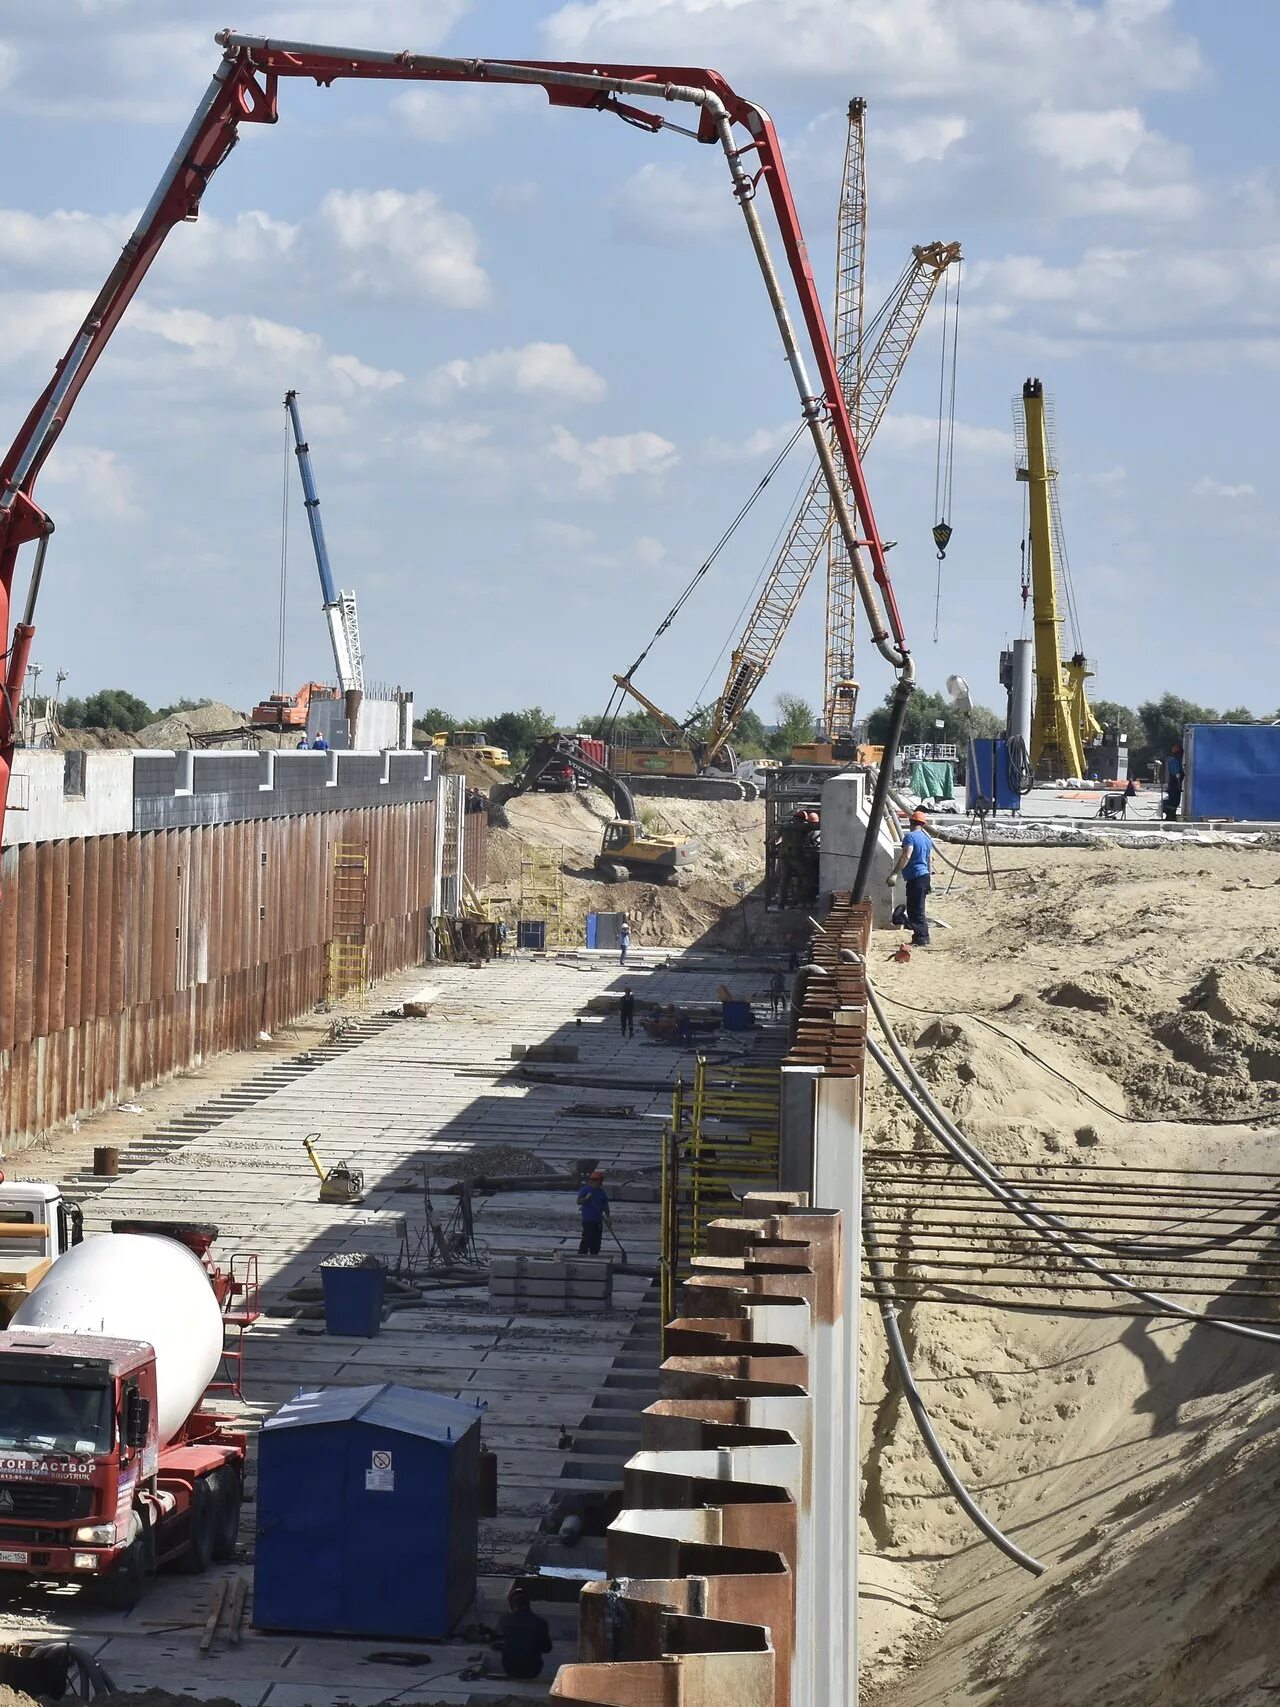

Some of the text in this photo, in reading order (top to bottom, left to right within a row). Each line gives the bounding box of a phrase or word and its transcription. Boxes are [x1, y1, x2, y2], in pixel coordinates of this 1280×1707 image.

[724, 662, 750, 713] LIEBHERR
[568, 759, 592, 777] VOLVO
[31, 1461, 96, 1474] РАСТВОР
[51, 1472, 90, 1480] SINOTRUK
